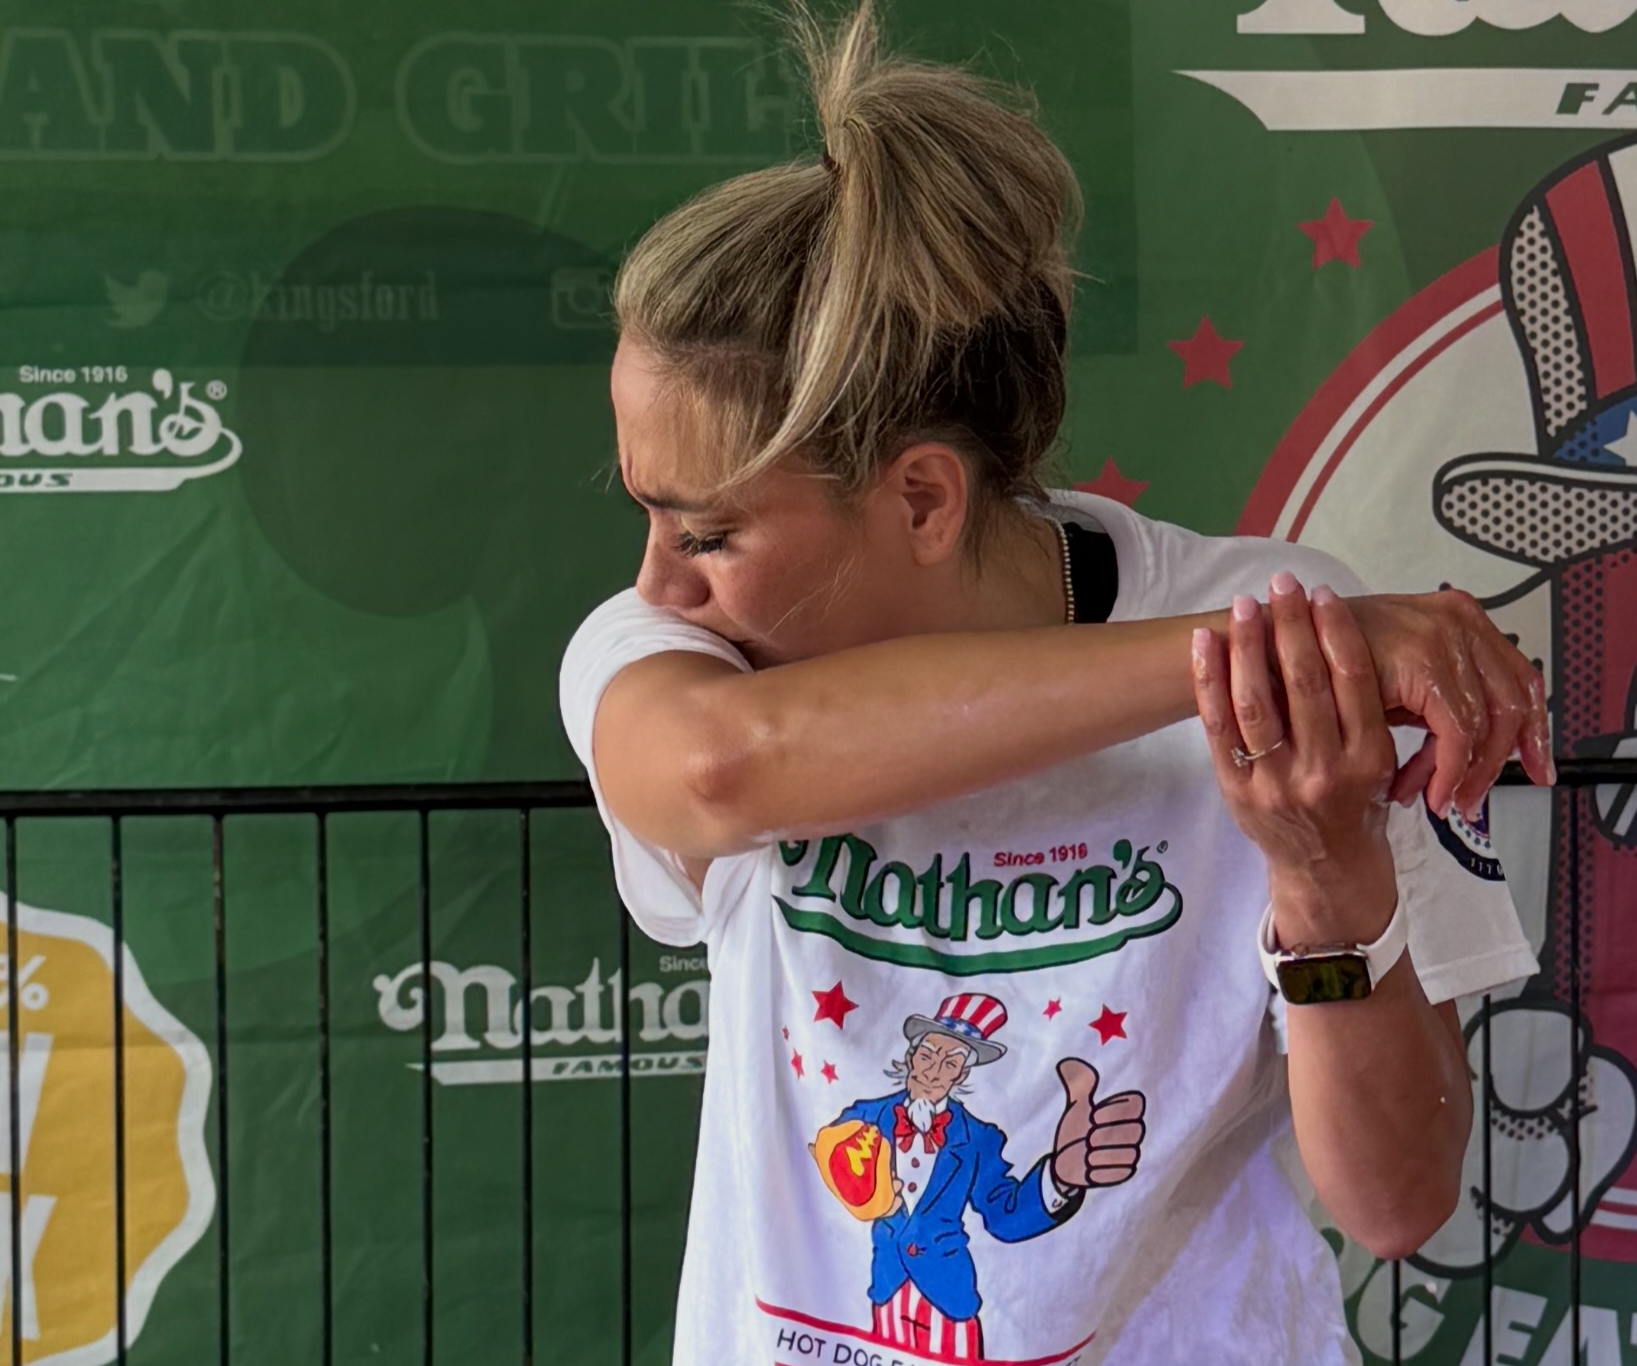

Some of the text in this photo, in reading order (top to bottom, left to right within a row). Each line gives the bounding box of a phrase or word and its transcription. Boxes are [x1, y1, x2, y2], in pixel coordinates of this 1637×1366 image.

[19, 365, 128, 383] Since 1916
[993, 843, 1089, 868] Since 1916
[776, 1328, 827, 1359] HOT
